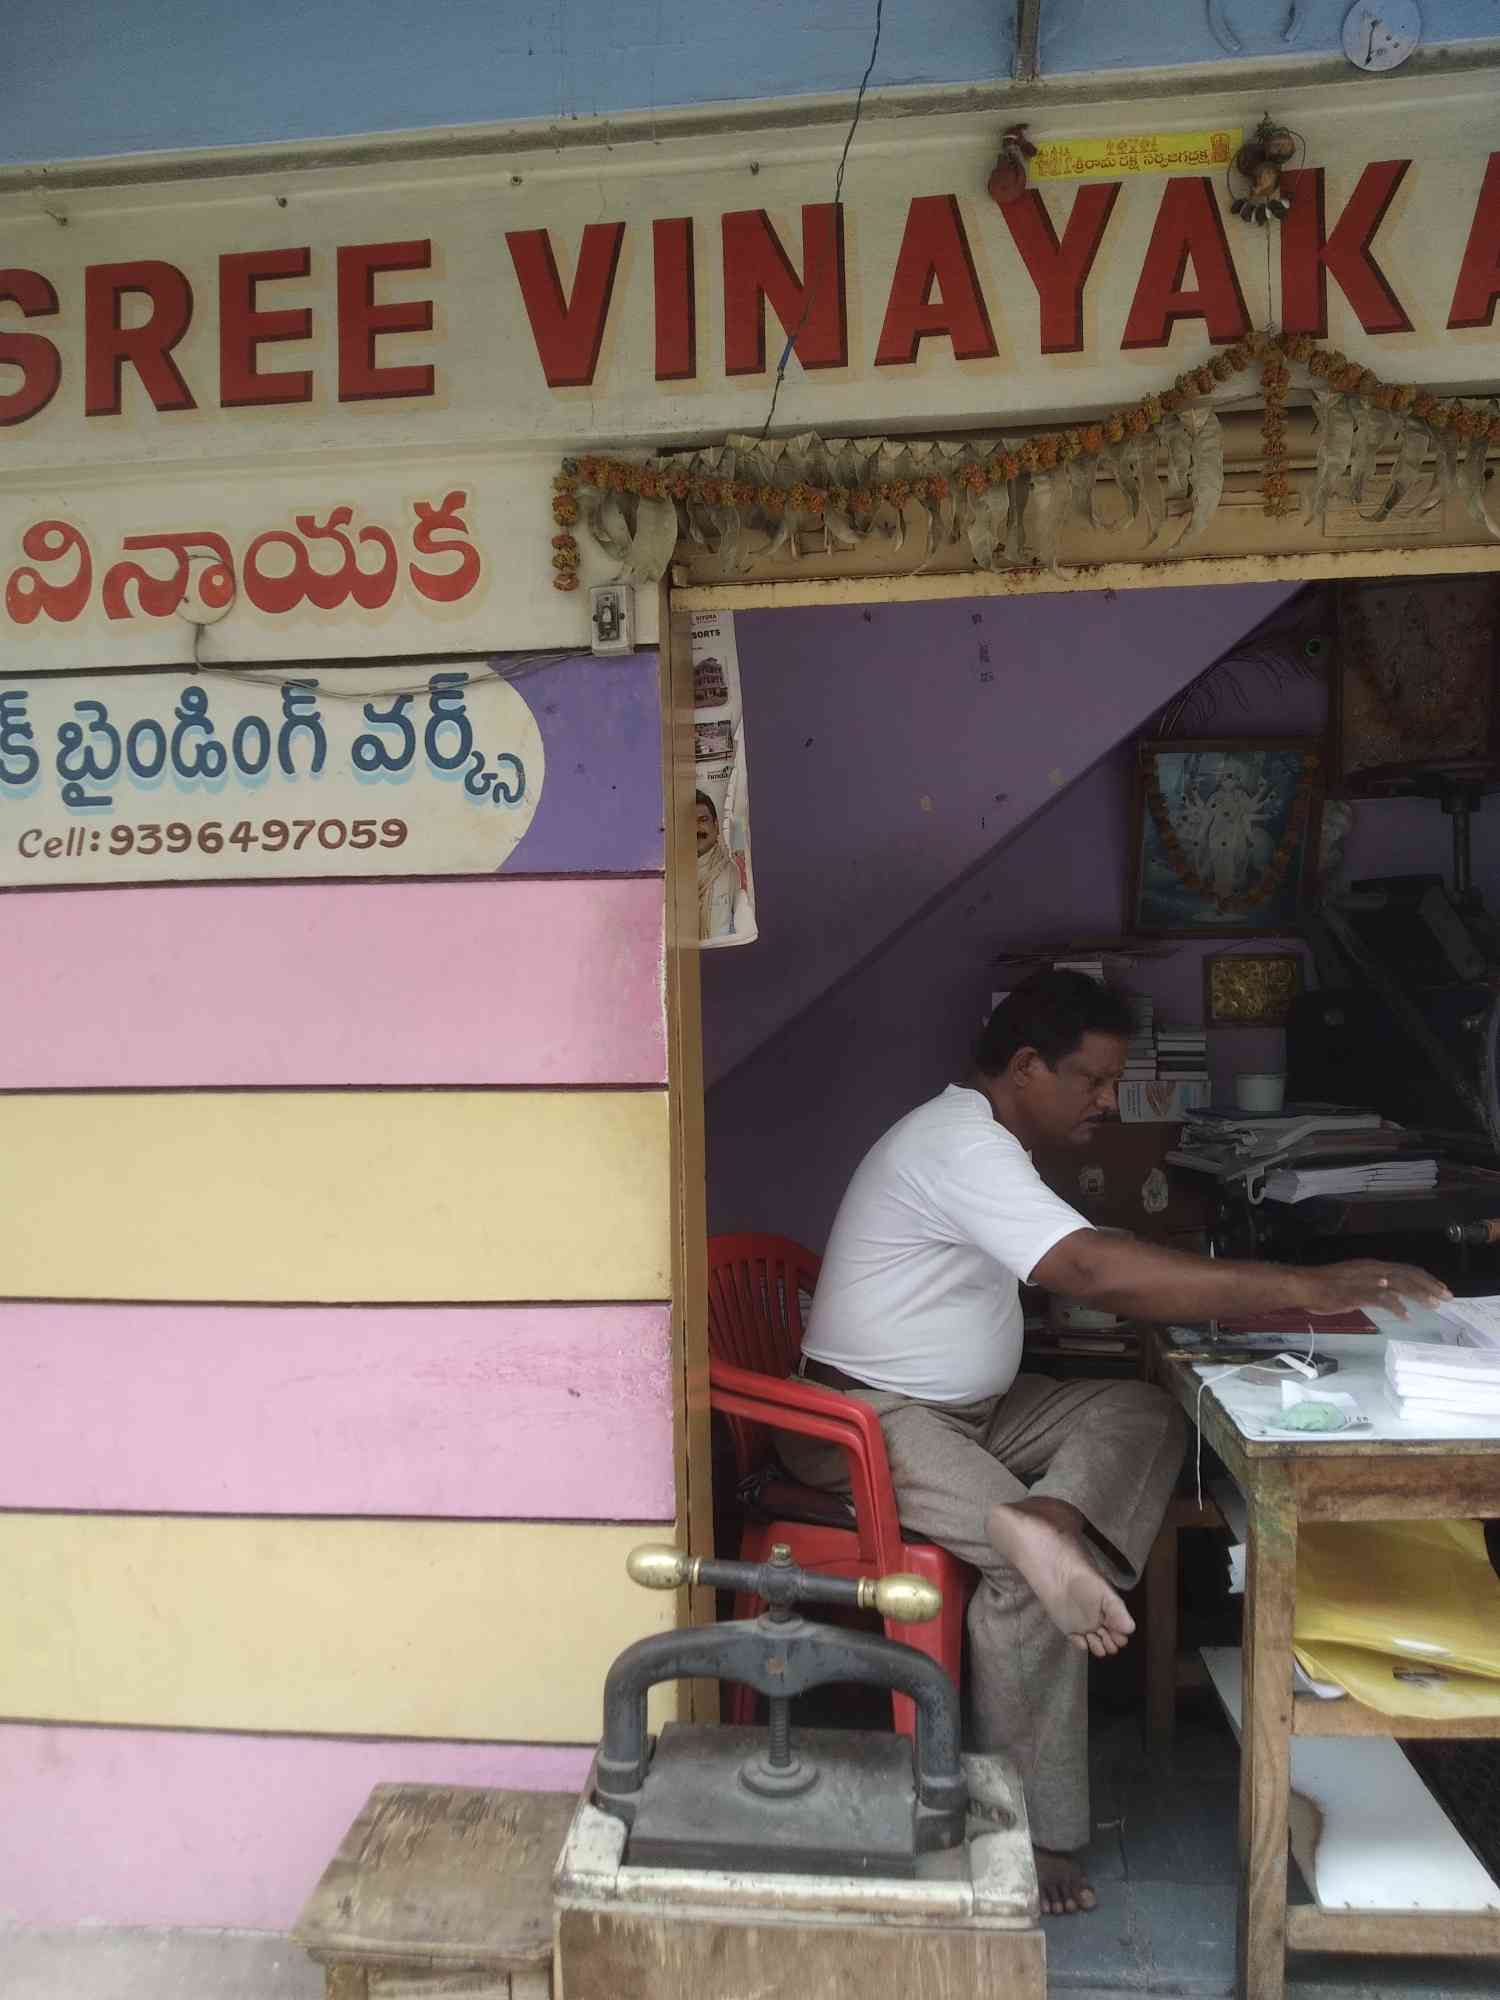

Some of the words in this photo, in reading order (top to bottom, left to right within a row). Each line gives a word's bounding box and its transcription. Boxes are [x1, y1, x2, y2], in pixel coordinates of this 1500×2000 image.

[0, 238, 437, 427] SREE
[4, 489, 482, 625] వినాయక
[55, 676, 327, 809] బైండింగ్
[350, 671, 527, 806] వర్క్స్
